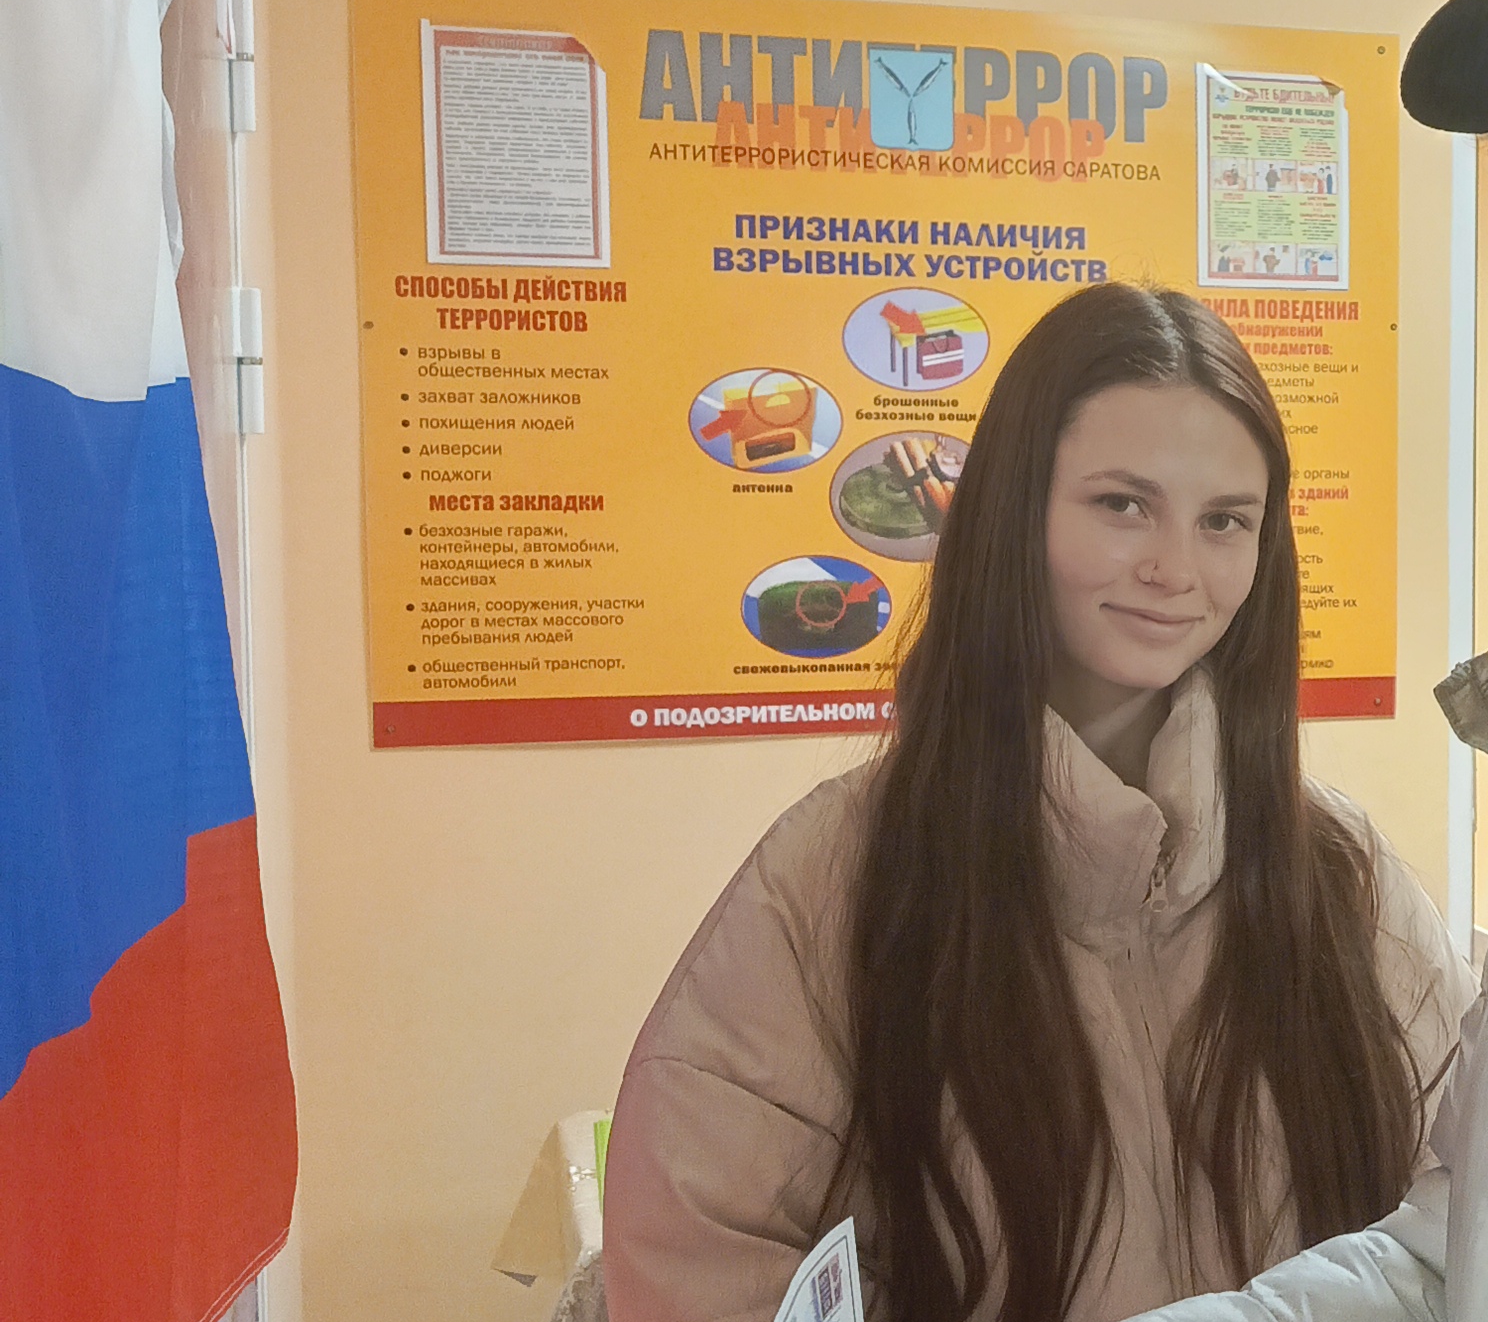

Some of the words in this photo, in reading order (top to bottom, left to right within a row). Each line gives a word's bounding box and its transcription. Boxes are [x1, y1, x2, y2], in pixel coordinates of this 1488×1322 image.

[640, 29, 1168, 144] АНТИРРОР
[649, 142, 931, 173] АНТИТЕРРОРИСТИЧЕСКАЯ
[939, 155, 1056, 178] КОМИССИЯ
[1063, 161, 1161, 182] САРАТОВА
[735, 213, 919, 245] ПРИЗНАКИ
[930, 221, 1086, 251] НАЛИЧИЯ
[713, 246, 917, 277] ВЗРЫВНЫХ
[924, 250, 1108, 283] УСТРОЙСТВ
[395, 275, 508, 300] СПОСОБЫ
[513, 275, 627, 304] ДЕЙСТВИЯ
[1254, 298, 1359, 323] ПОВЕДЕНИЯ
[436, 307, 588, 332] ТЕРРОРИСТОВ
[417, 347, 485, 361] взрывы
[491, 348, 501, 360] в
[1253, 342, 1333, 357] предметов:
[417, 362, 545, 379] общественных
[551, 367, 610, 380] местах
[1258, 362, 1310, 373] зхозные
[1313, 363, 1348, 374] вещи
[1351, 363, 1359, 373] и
[1267, 377, 1315, 388] едметы
[417, 391, 475, 404] захват
[479, 391, 582, 405] заложников
[872, 395, 959, 408] брошенные
[1275, 391, 1339, 404] озможной
[418, 417, 516, 431] похищения
[521, 415, 575, 431] людей
[855, 409, 935, 422] безхозные
[938, 411, 977, 423] вещи
[418, 443, 503, 458] диверсии
[420, 469, 492, 483] поджоги
[1303, 469, 1350, 480] органы
[1298, 485, 1349, 501] зданий
[429, 494, 495, 511] места
[499, 494, 604, 514] закладки
[418, 523, 503, 537] безхозные
[507, 525, 568, 540] гаражи,
[420, 540, 519, 556] контейнеры,
[523, 539, 619, 554] автомобили,
[420, 558, 525, 572] находящиеся
[530, 558, 539, 569] в
[543, 557, 593, 570] жилых
[420, 574, 497, 587] массивах
[420, 601, 481, 614] здания,
[485, 598, 583, 615] сооружения,
[586, 597, 645, 613] участки
[1300, 596, 1340, 611] едуйте
[1343, 598, 1358, 608] их
[421, 617, 465, 632] дорог
[470, 617, 479, 628] в
[484, 615, 538, 628] местах
[543, 614, 624, 627] массового
[421, 631, 520, 646] пребывания
[524, 628, 573, 643] людей
[422, 656, 540, 675] общественный
[544, 657, 626, 674] транспорт,
[733, 661, 871, 675] свежевыкопанная
[422, 674, 517, 690] автомобили
[630, 708, 648, 727] О
[654, 702, 875, 728] ПОДОЗРИТЕЛЬНОМ
